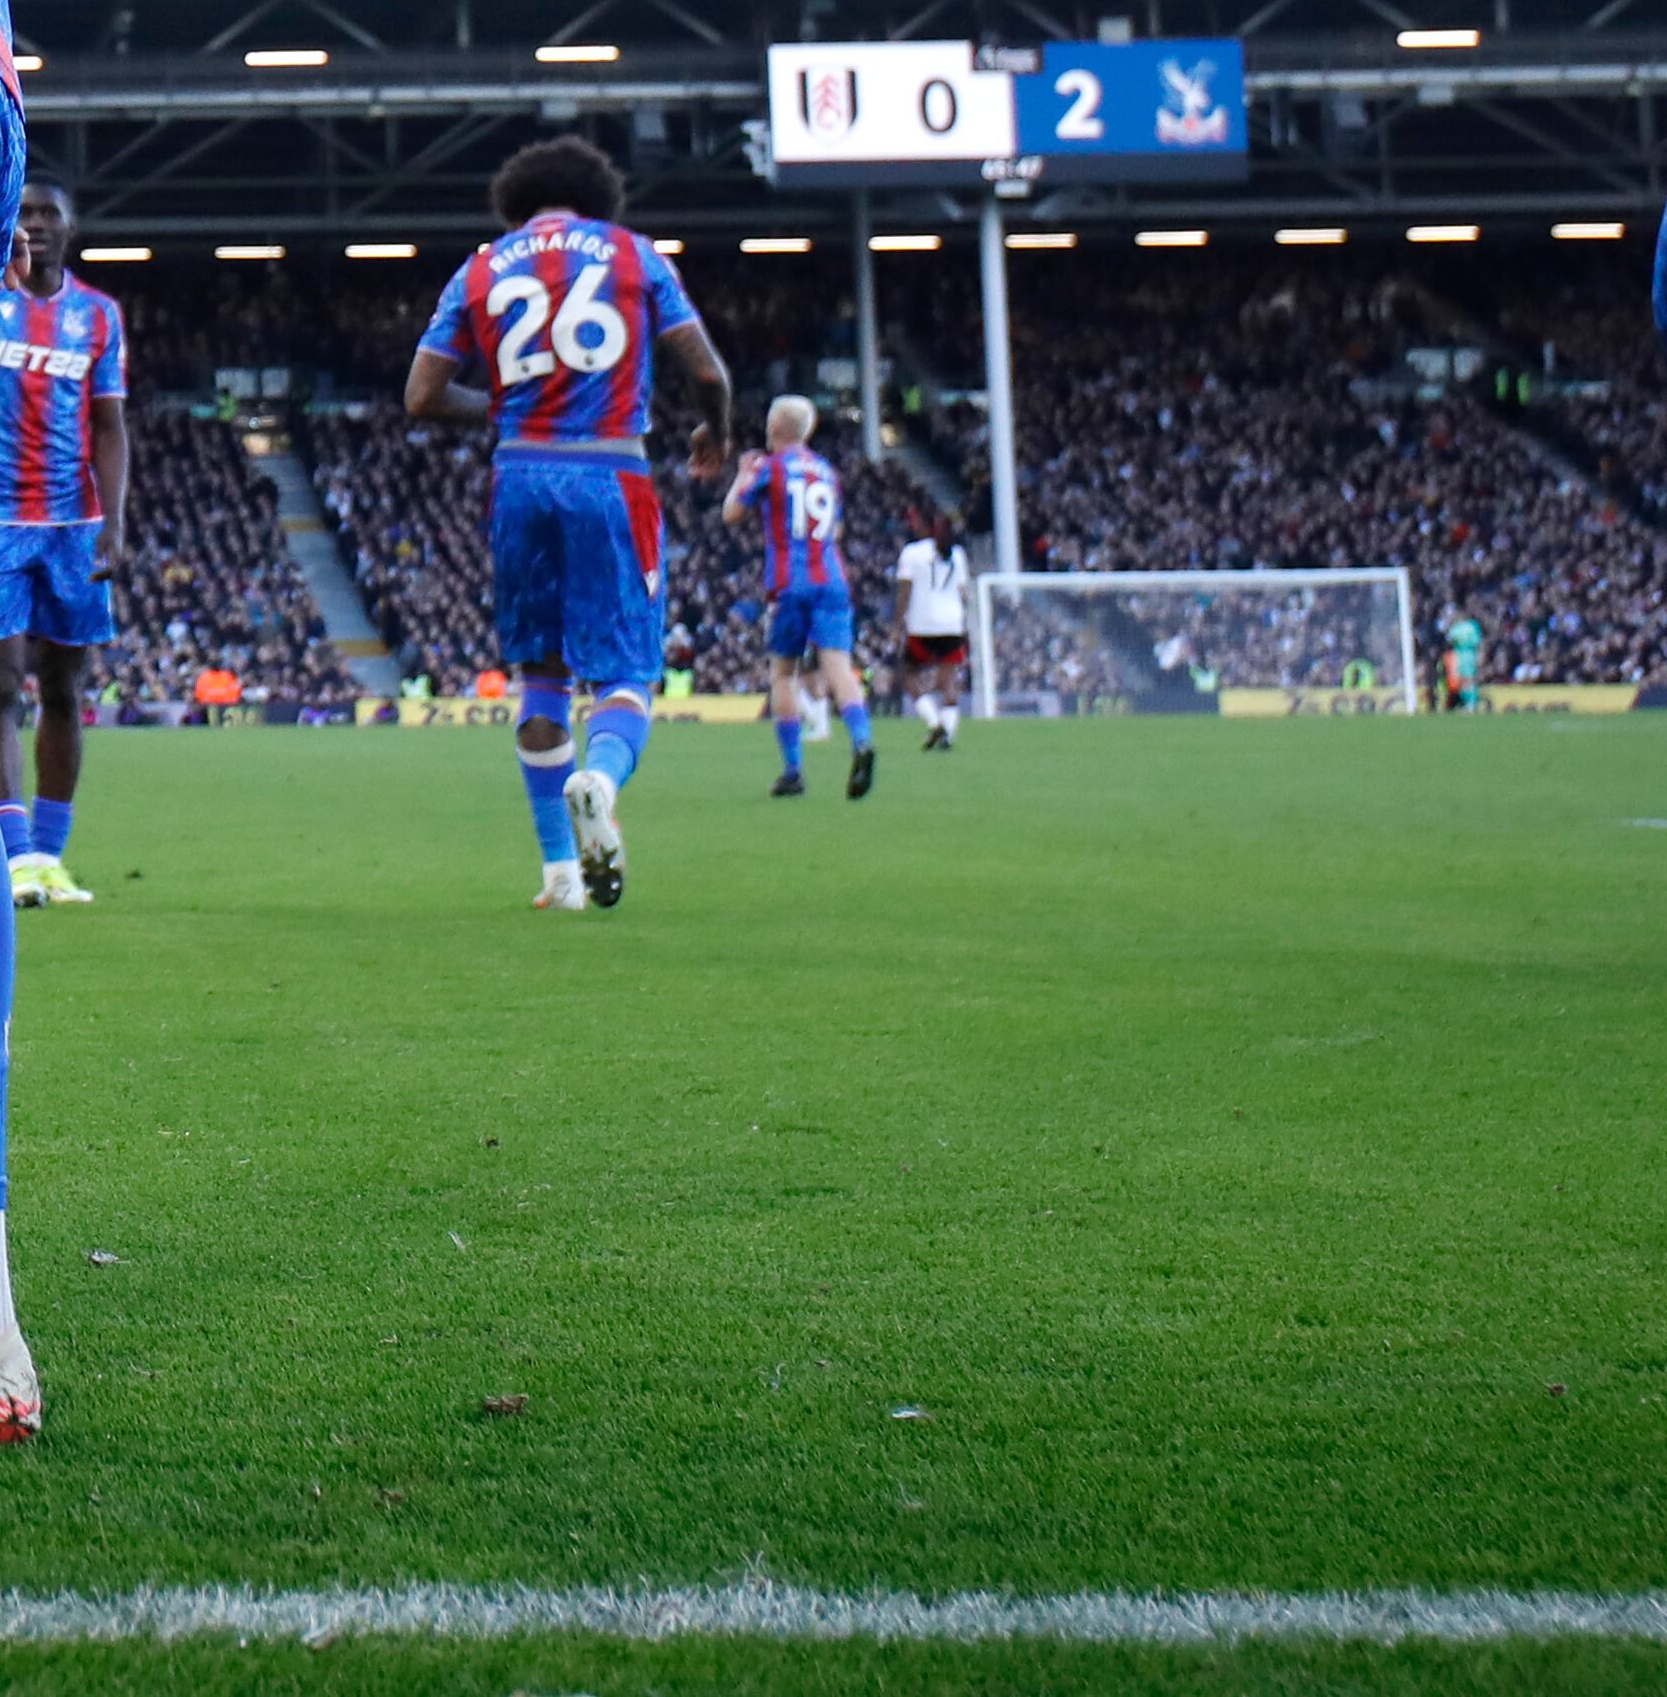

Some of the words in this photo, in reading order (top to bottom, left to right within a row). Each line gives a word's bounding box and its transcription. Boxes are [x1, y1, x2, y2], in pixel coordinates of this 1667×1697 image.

[919, 78, 957, 133] 0
[1054, 68, 1105, 139] 2
[489, 230, 617, 274] RICHARDS
[487, 264, 628, 387] 26
[786, 477, 835, 541] 19
